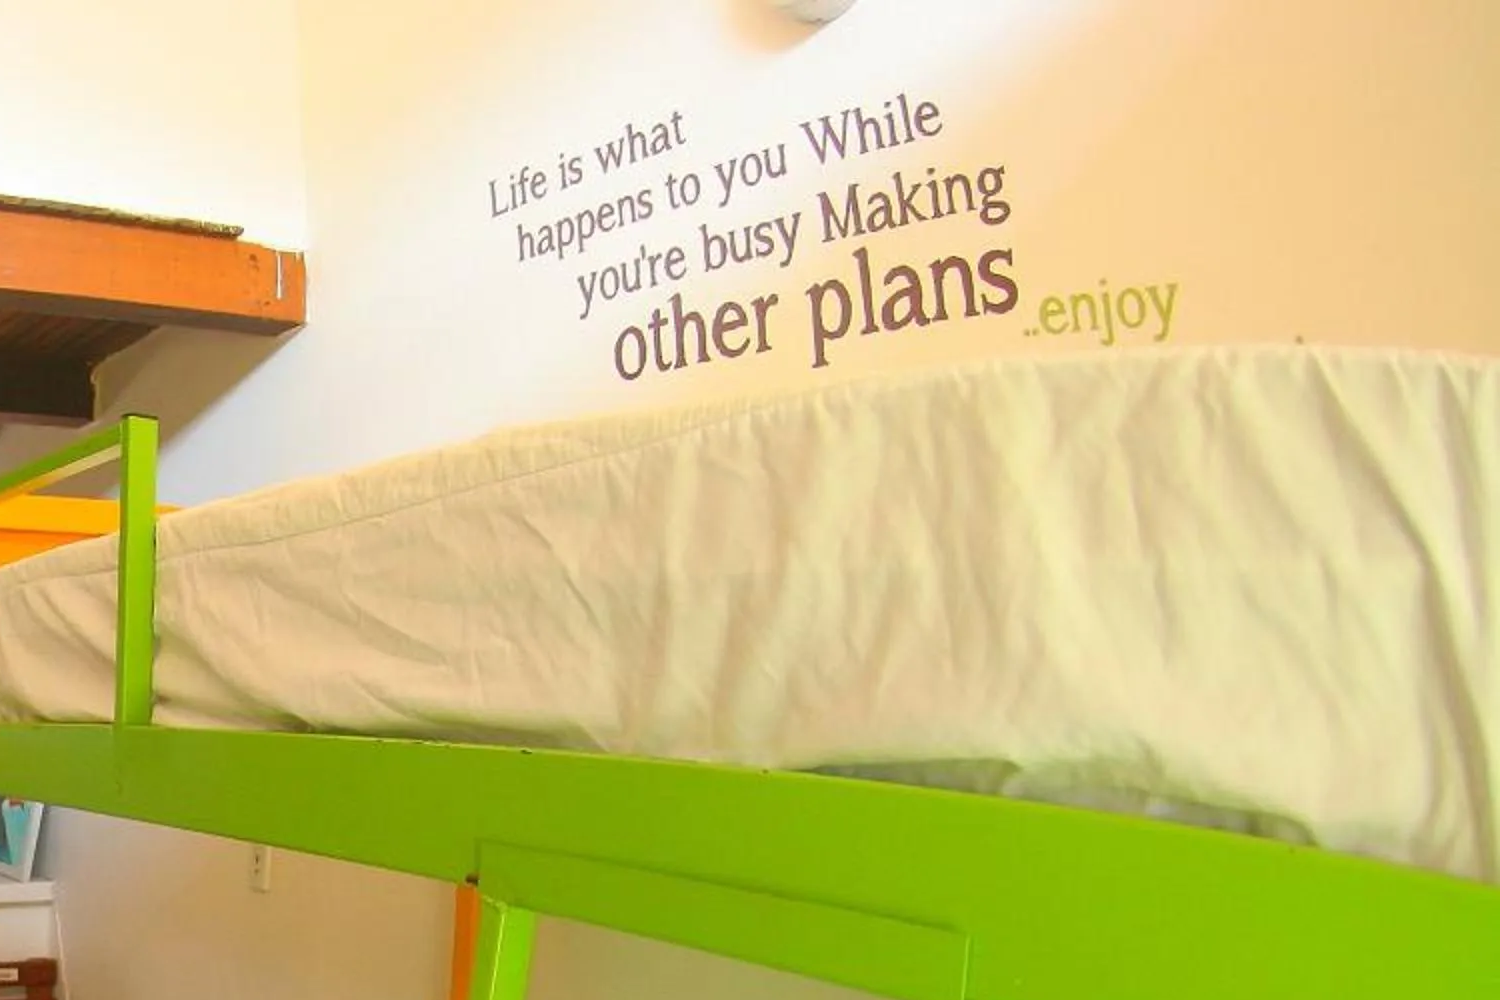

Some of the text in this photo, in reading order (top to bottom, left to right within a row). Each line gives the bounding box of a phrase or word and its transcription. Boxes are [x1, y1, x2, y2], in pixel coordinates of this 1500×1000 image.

[488, 111, 687, 218] Life is what
[516, 93, 944, 262] happens to you While
[576, 165, 1013, 320] you're busy Making
[613, 245, 1020, 381] other plans
